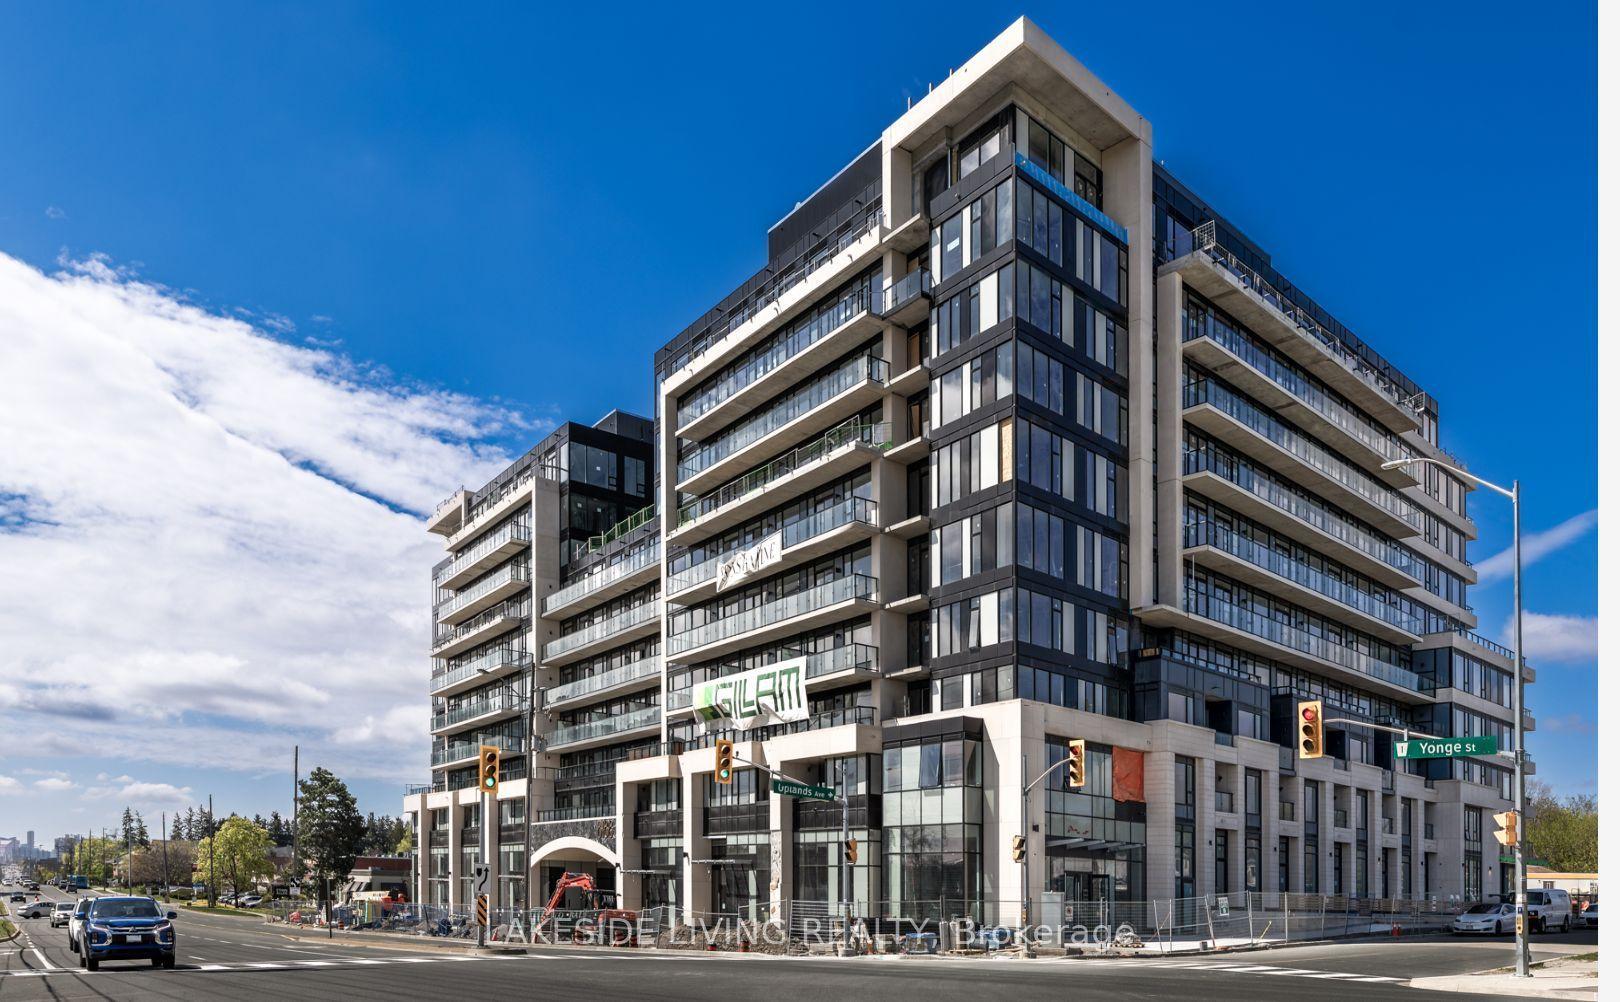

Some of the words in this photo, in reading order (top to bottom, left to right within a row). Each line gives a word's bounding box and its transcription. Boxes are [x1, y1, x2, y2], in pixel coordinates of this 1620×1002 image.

[1420, 742, 1461, 756] Yonge
[777, 783, 812, 796] Uplands
[814, 790, 825, 798] Ave
